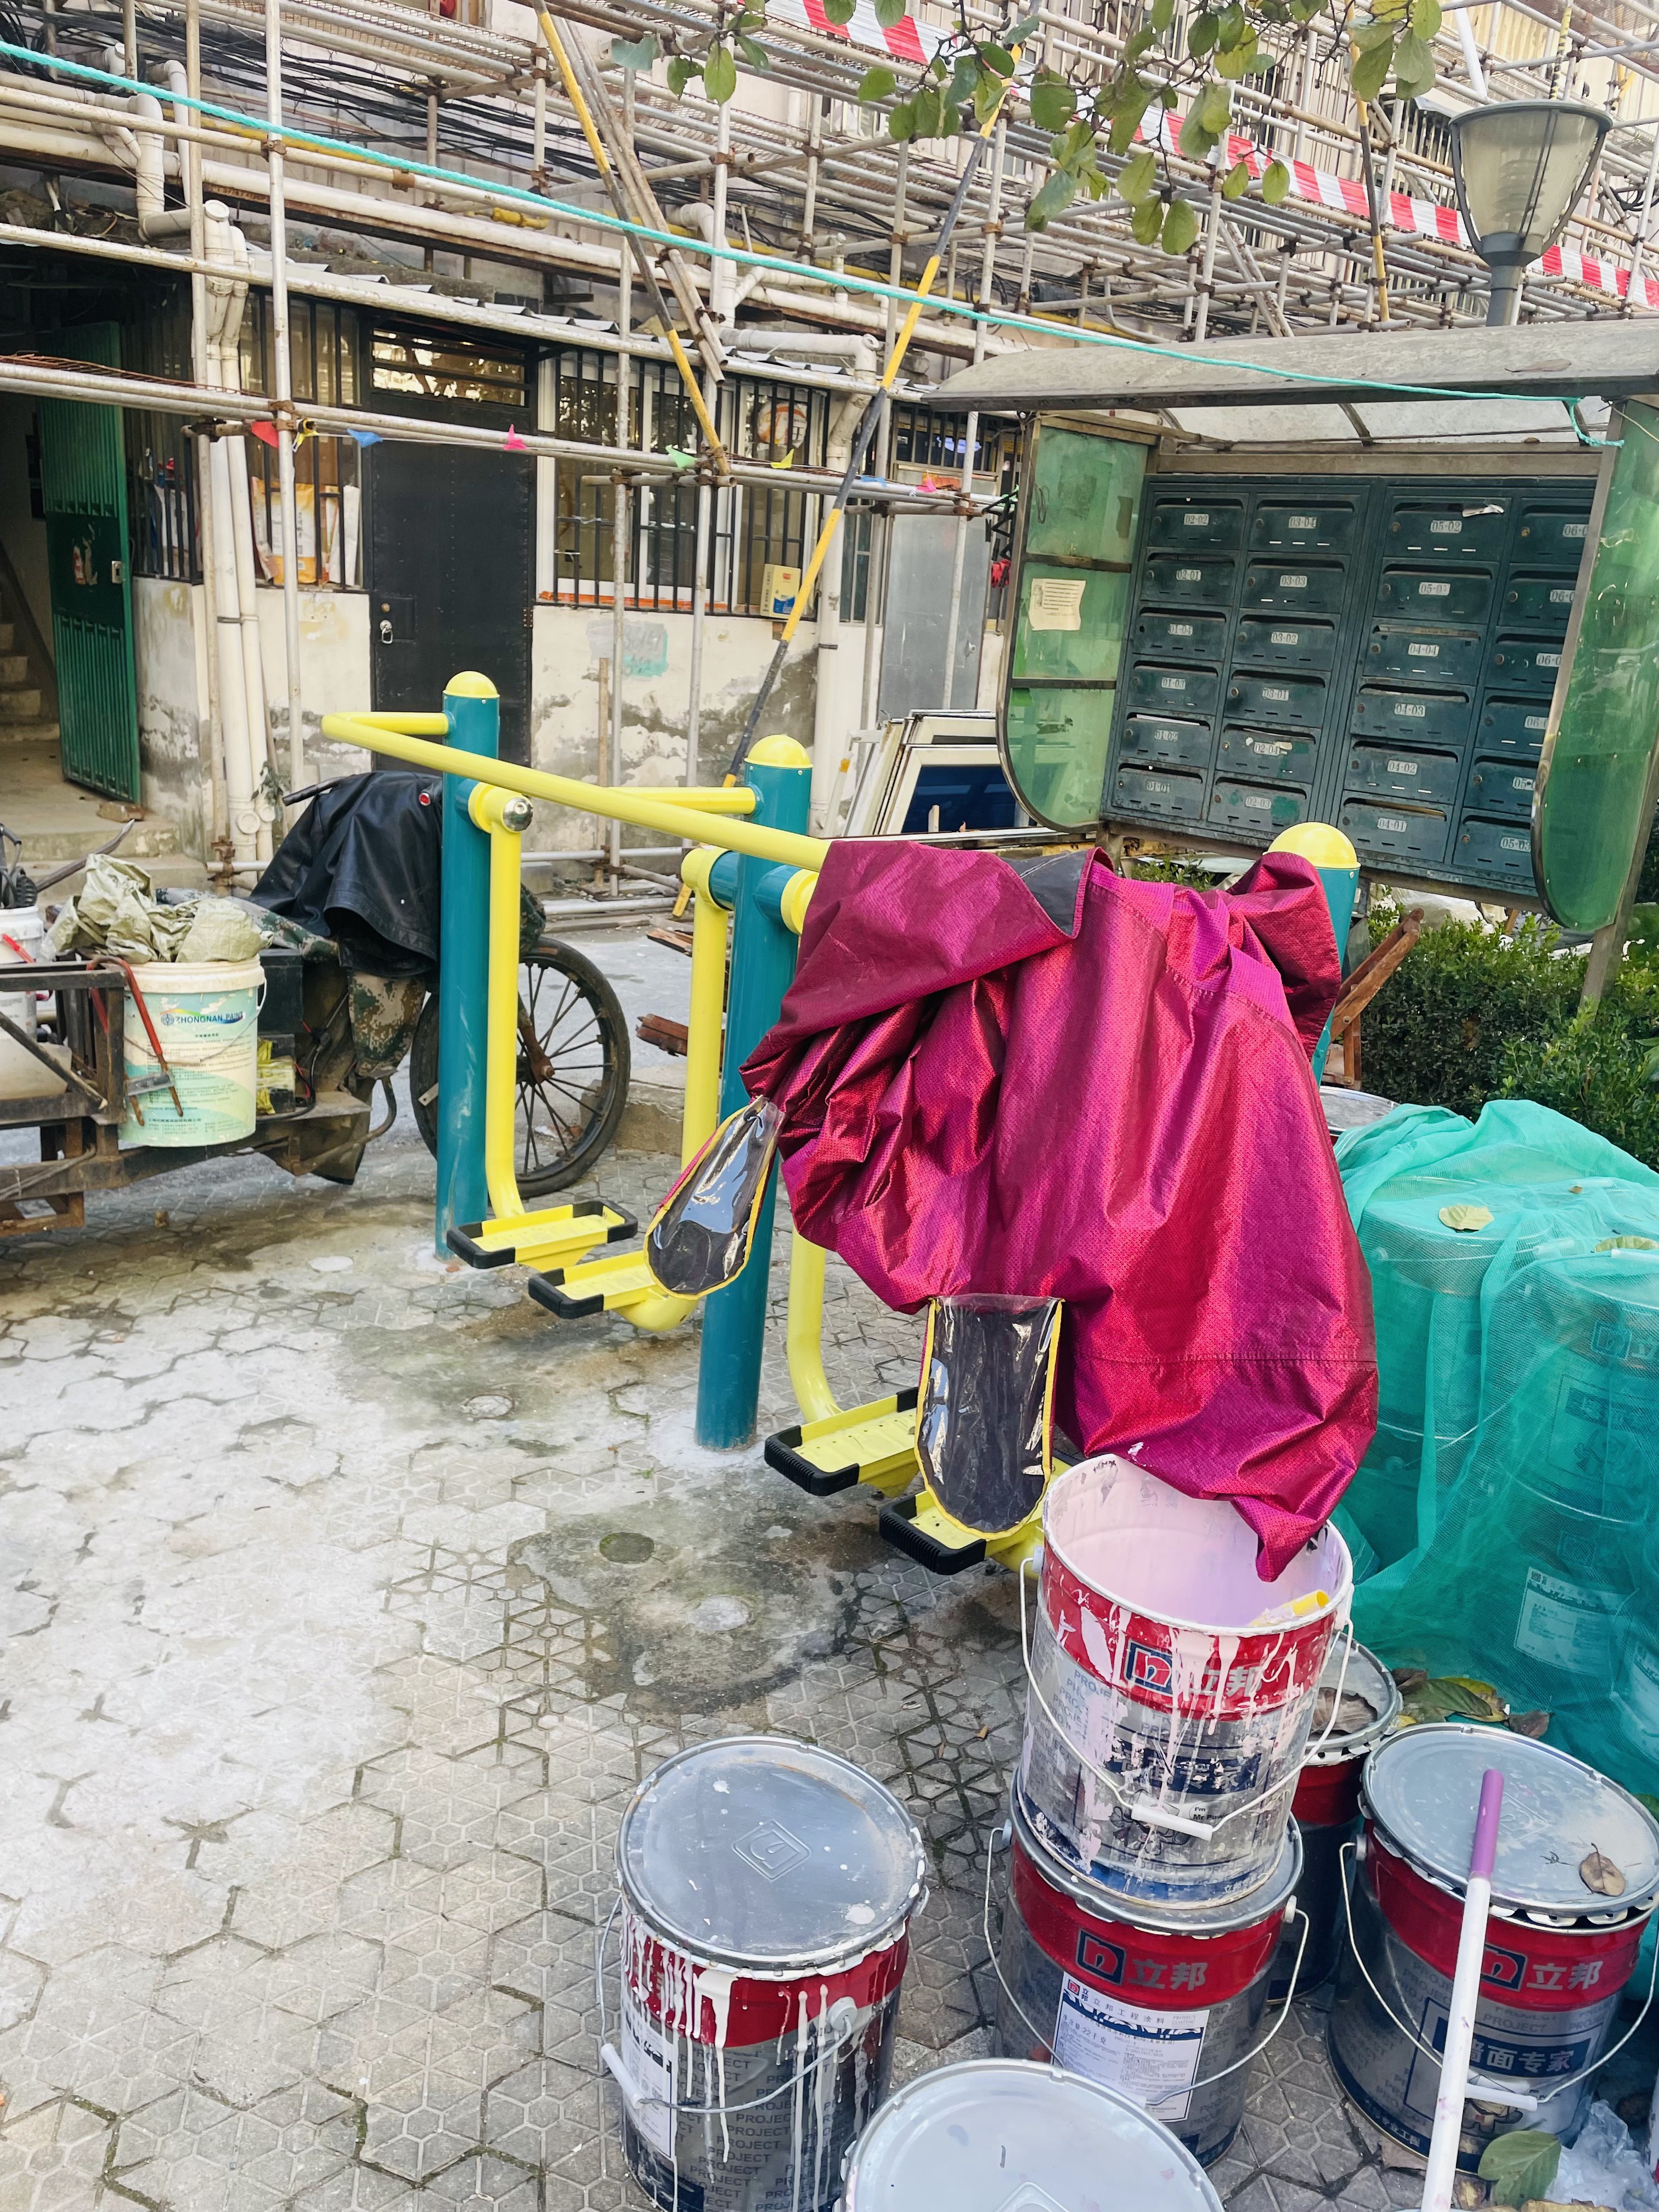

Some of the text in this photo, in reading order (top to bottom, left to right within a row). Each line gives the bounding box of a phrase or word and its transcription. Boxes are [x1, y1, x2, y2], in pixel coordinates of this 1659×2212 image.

[176, 1011, 244, 1024] ZHONGNAN PAINT
[1128, 1958, 1209, 1992] 立邦
[1526, 1960, 1604, 1990] 立邦
[1092, 1997, 1165, 2025] 立邦工程涂料
[1483, 2014, 1547, 2033] PROJECT
